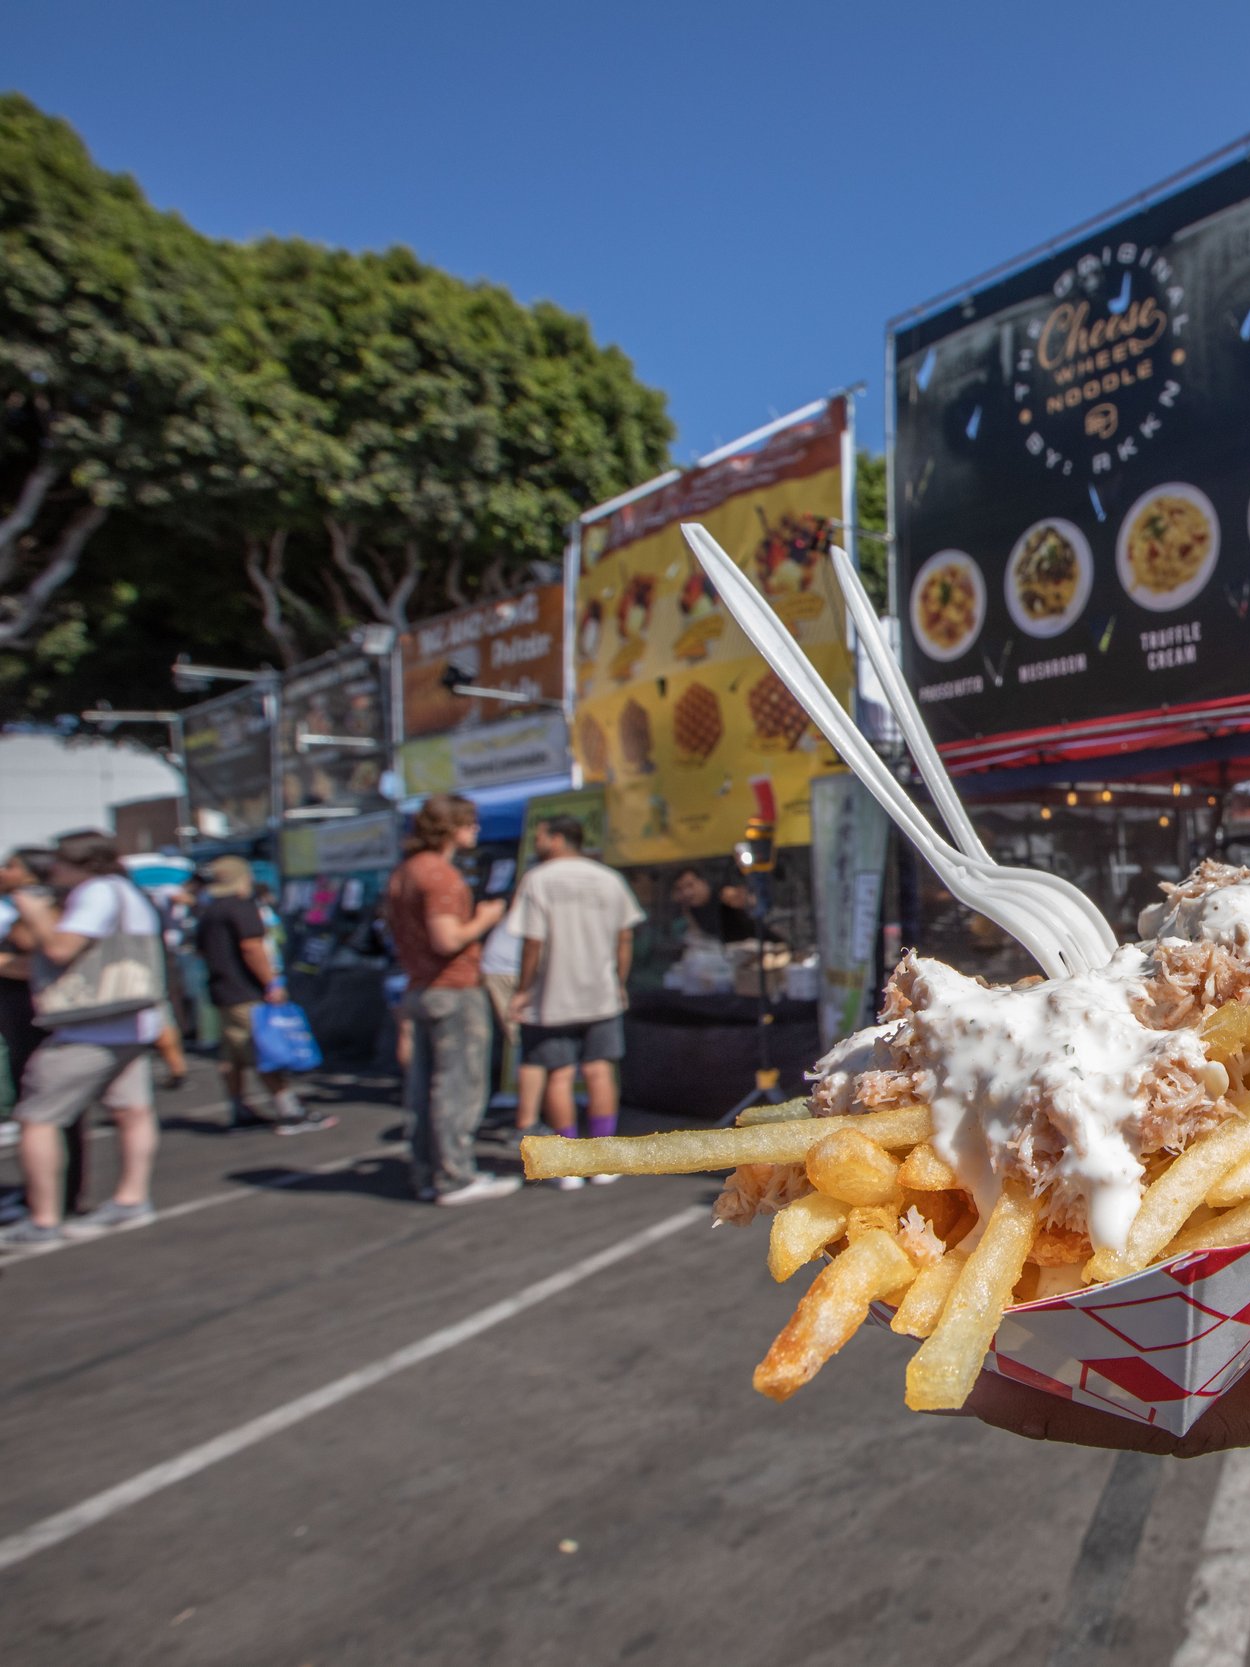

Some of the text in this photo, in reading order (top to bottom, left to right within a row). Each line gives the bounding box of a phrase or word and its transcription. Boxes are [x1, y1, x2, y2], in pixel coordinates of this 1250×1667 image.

[1037, 297, 1168, 371] Cheese
[1053, 336, 1147, 385] WHEEL
[1046, 357, 1153, 415] NOODLE
[1140, 621, 1202, 651] TRUFFLE
[1147, 644, 1197, 671] CREAM
